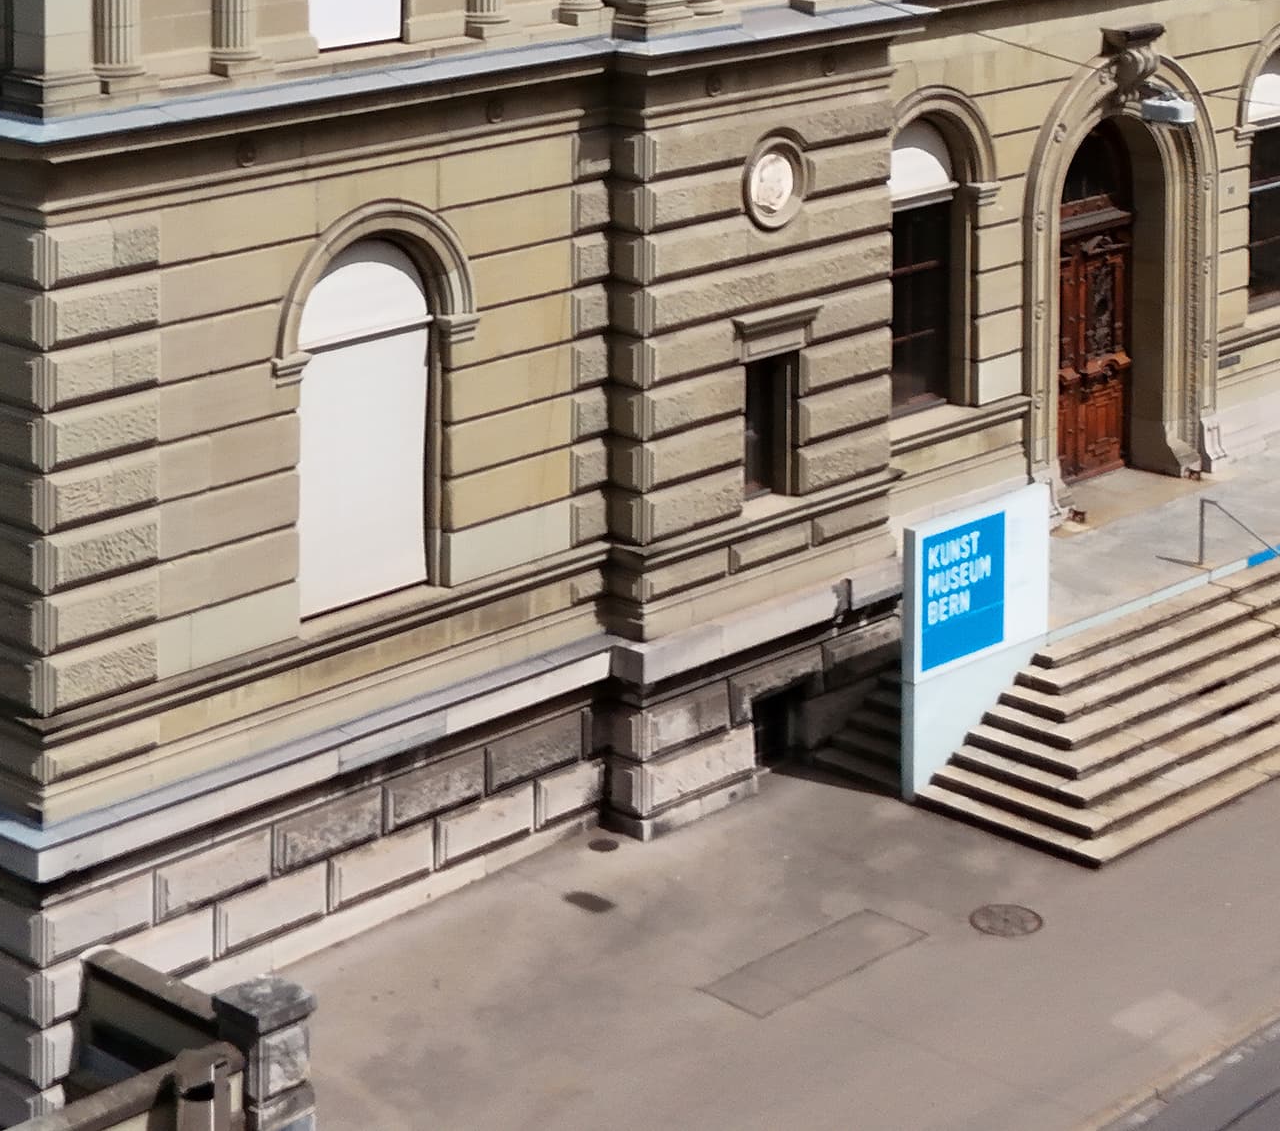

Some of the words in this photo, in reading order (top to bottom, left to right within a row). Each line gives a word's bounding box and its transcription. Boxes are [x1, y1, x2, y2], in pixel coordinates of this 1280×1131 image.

[928, 531, 980, 570] KUNST
[928, 555, 991, 597] MUSEUM
[928, 590, 970, 625] BERN
